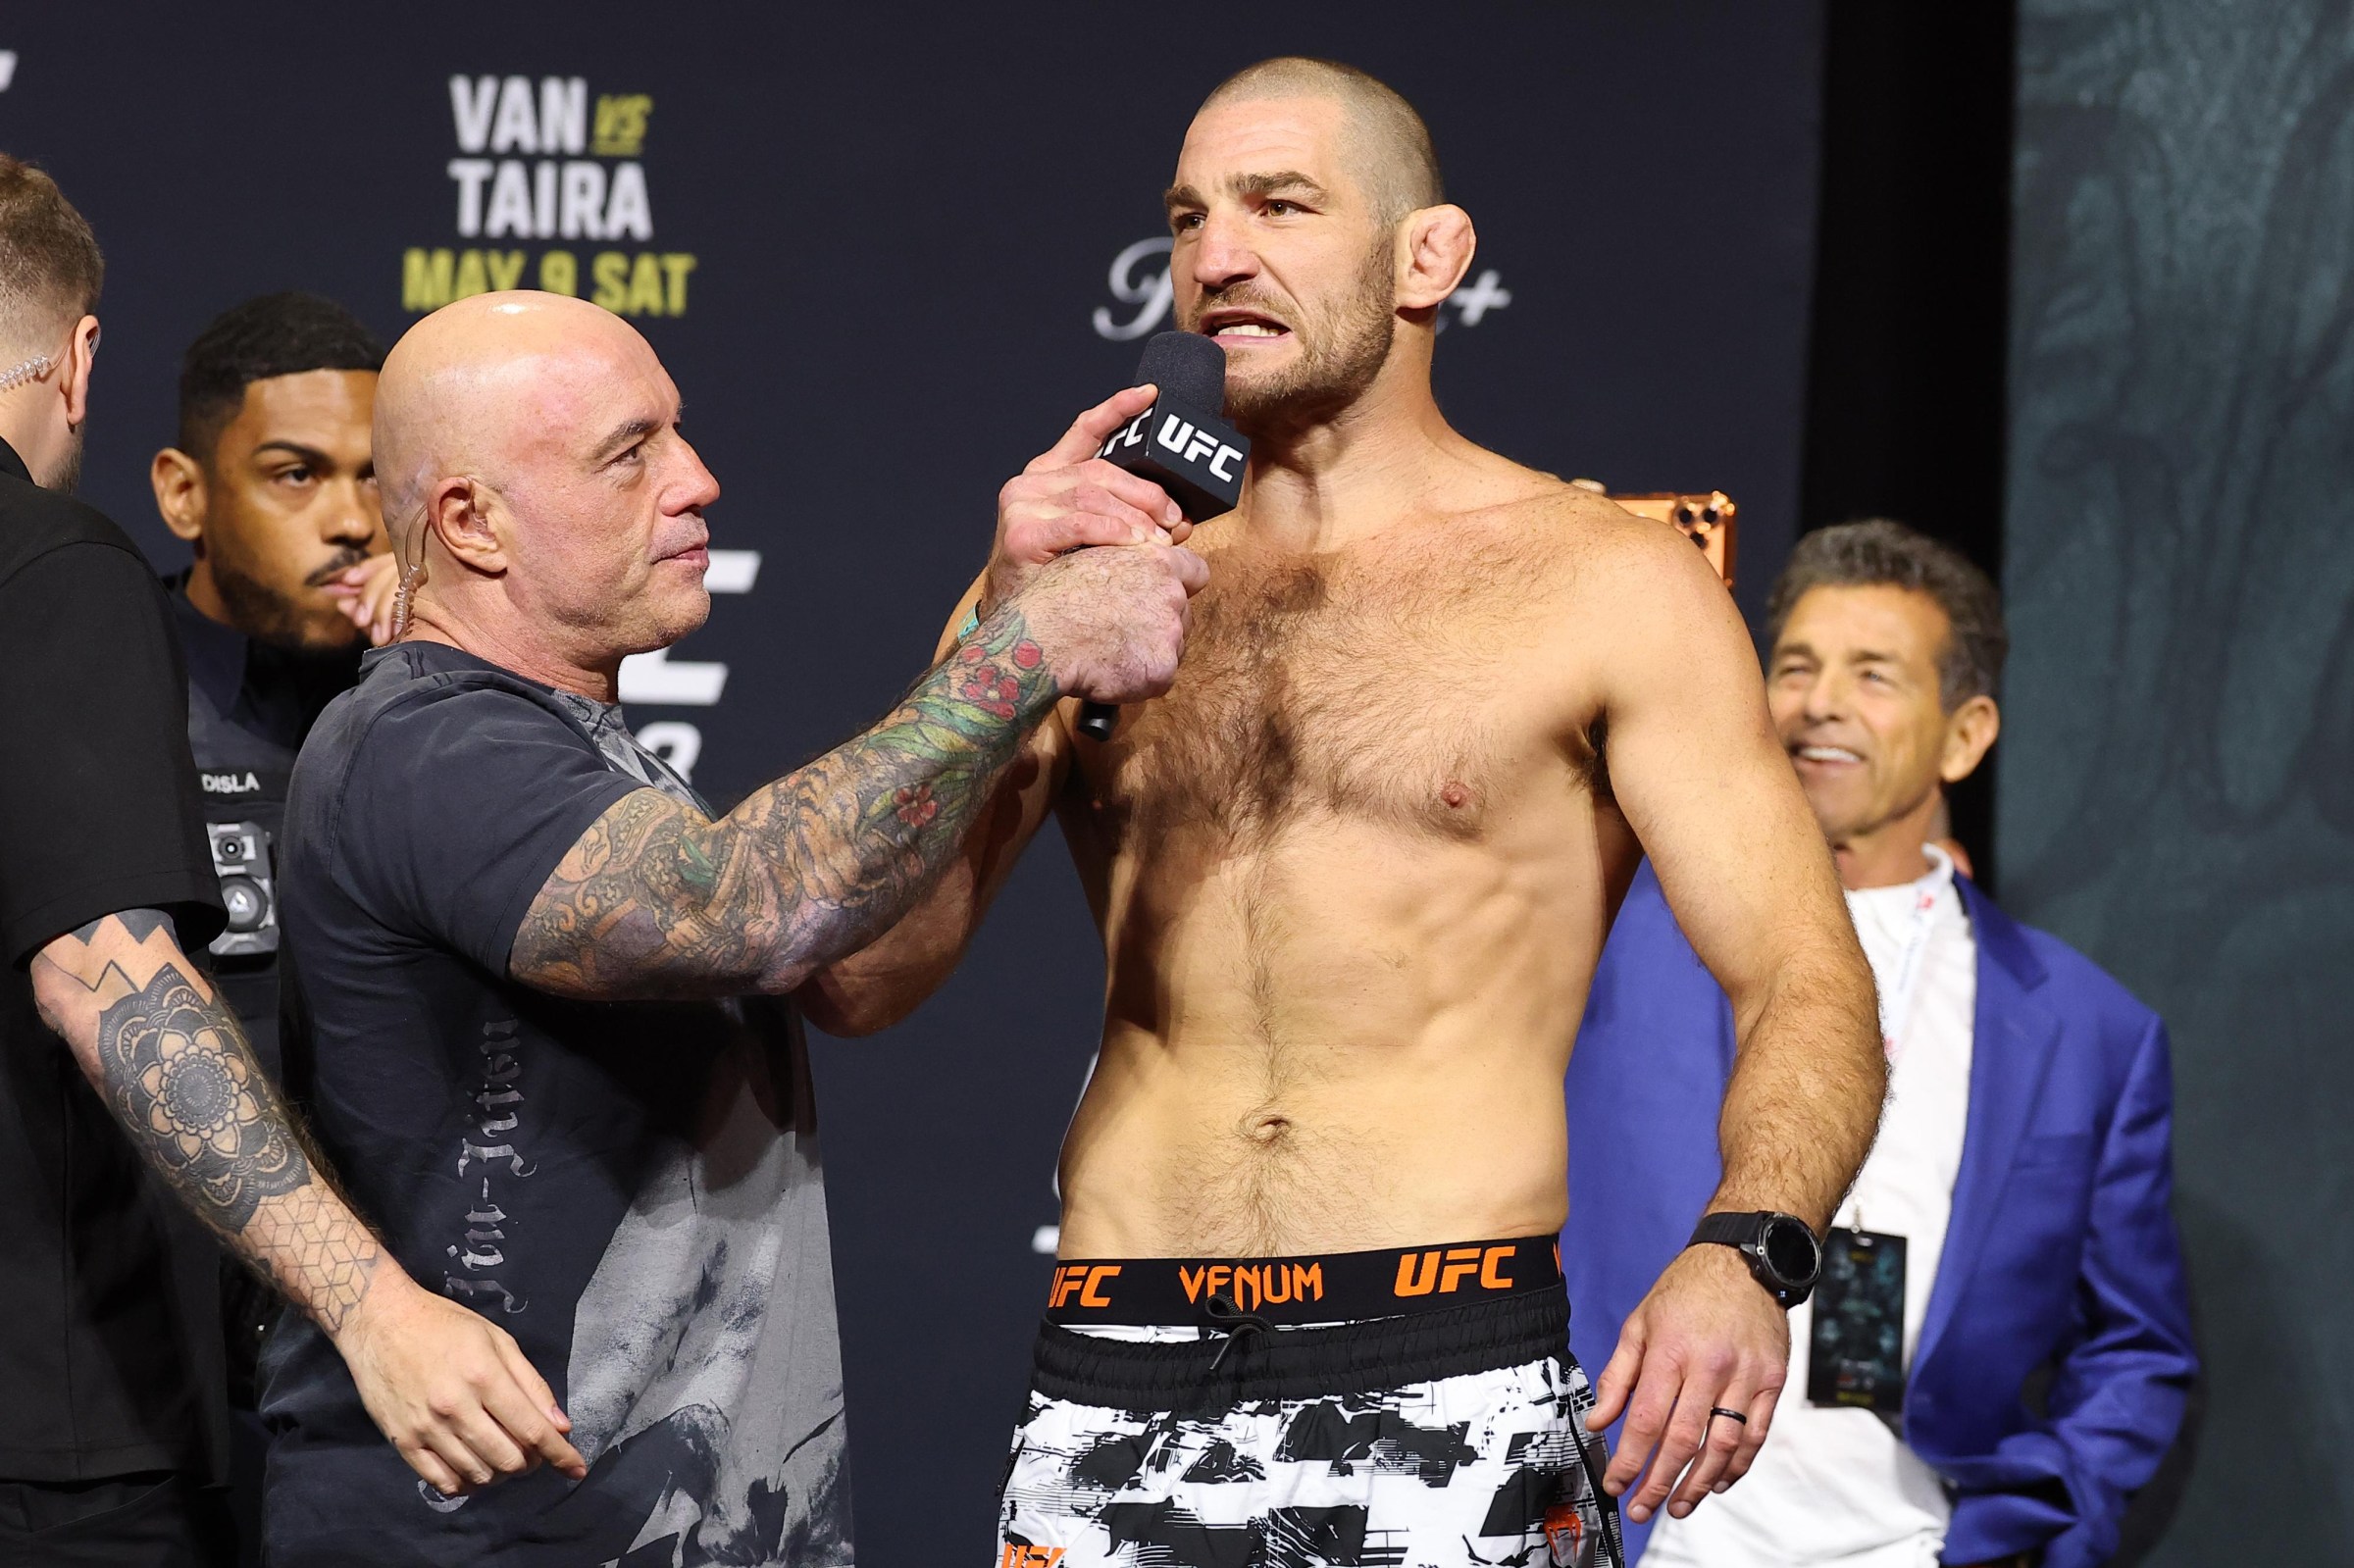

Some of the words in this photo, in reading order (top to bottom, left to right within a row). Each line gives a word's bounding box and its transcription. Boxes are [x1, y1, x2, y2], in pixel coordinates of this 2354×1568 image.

[448, 74, 588, 155] VAN
[592, 94, 653, 156] VS
[446, 159, 653, 241] TAIRA
[402, 248, 527, 312] MAY
[540, 250, 578, 298] 9
[591, 251, 697, 317] SAT
[1156, 413, 1244, 483] UFC
[201, 771, 261, 793] DISLA
[1179, 1262, 1323, 1312] VENUM
[1394, 1245, 1516, 1297] UFC
